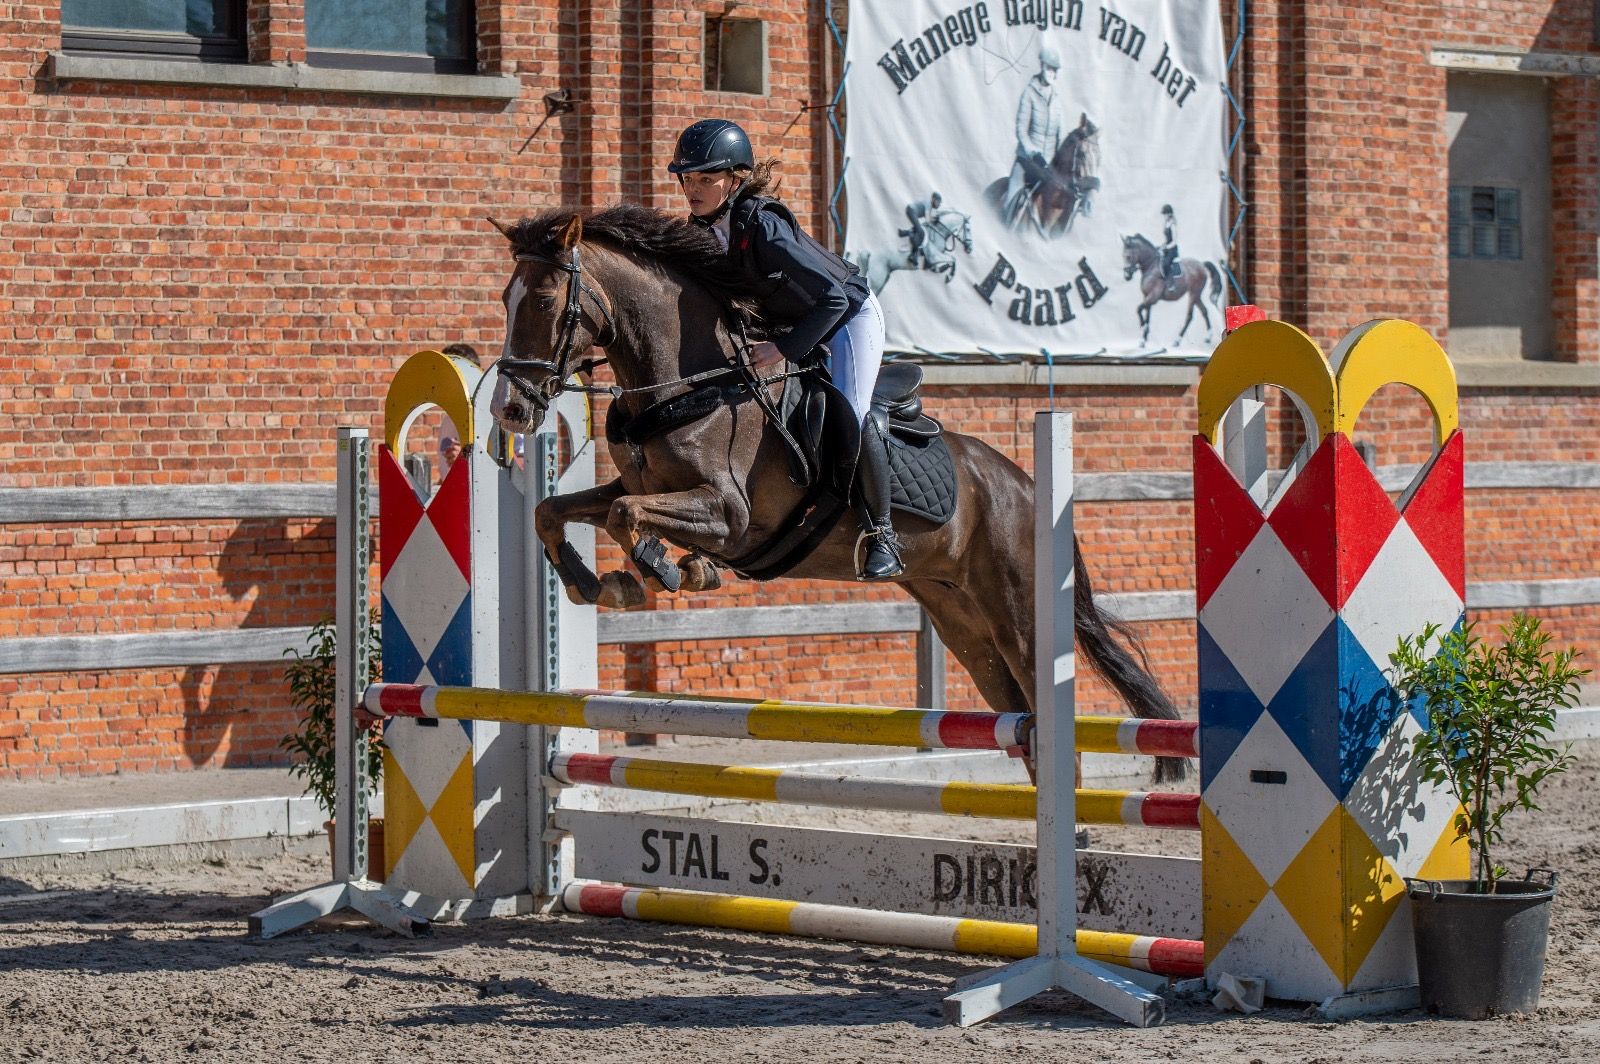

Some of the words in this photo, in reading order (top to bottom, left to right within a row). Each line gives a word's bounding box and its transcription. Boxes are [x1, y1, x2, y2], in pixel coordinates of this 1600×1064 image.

[877, 1, 991, 95] Manege
[1003, 0, 1083, 32] dagen
[1099, 7, 1147, 61] van
[1151, 41, 1197, 108] het
[973, 251, 1109, 327] Paard
[641, 828, 730, 881] STAL
[749, 838, 781, 887] S.
[933, 853, 1114, 916] DIRICX
